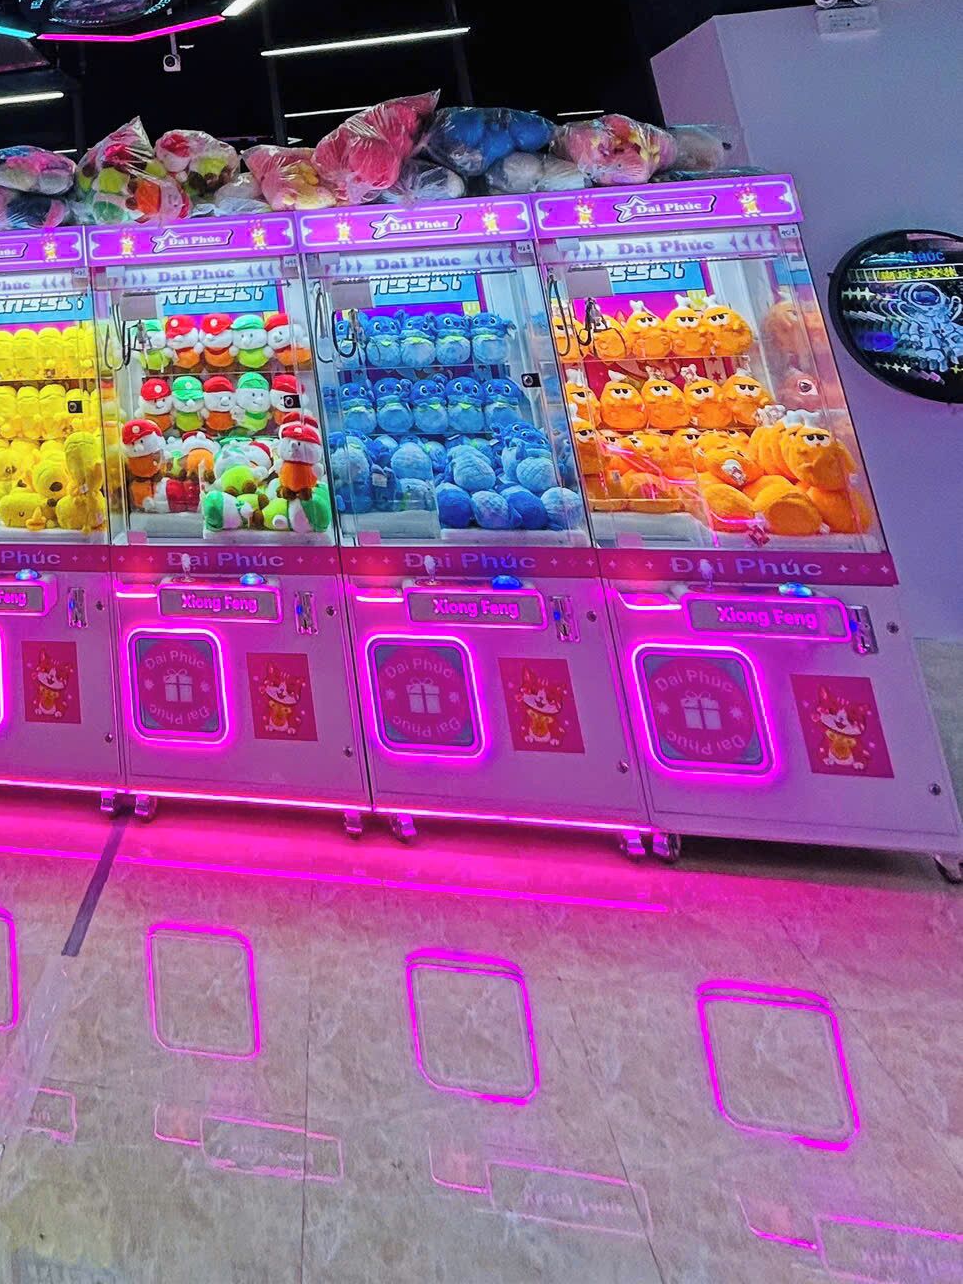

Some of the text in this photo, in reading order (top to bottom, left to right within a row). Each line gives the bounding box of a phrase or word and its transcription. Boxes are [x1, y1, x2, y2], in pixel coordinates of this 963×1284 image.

[1, 549, 61, 564] Phúc
[218, 551, 284, 567] Phúc
[460, 552, 536, 569] Phúc
[669, 556, 822, 576] Đi Phúc
[181, 593, 257, 613] Xiong Feng
[433, 598, 519, 619] Xiong Feng
[716, 606, 818, 629] Xiong Feng
